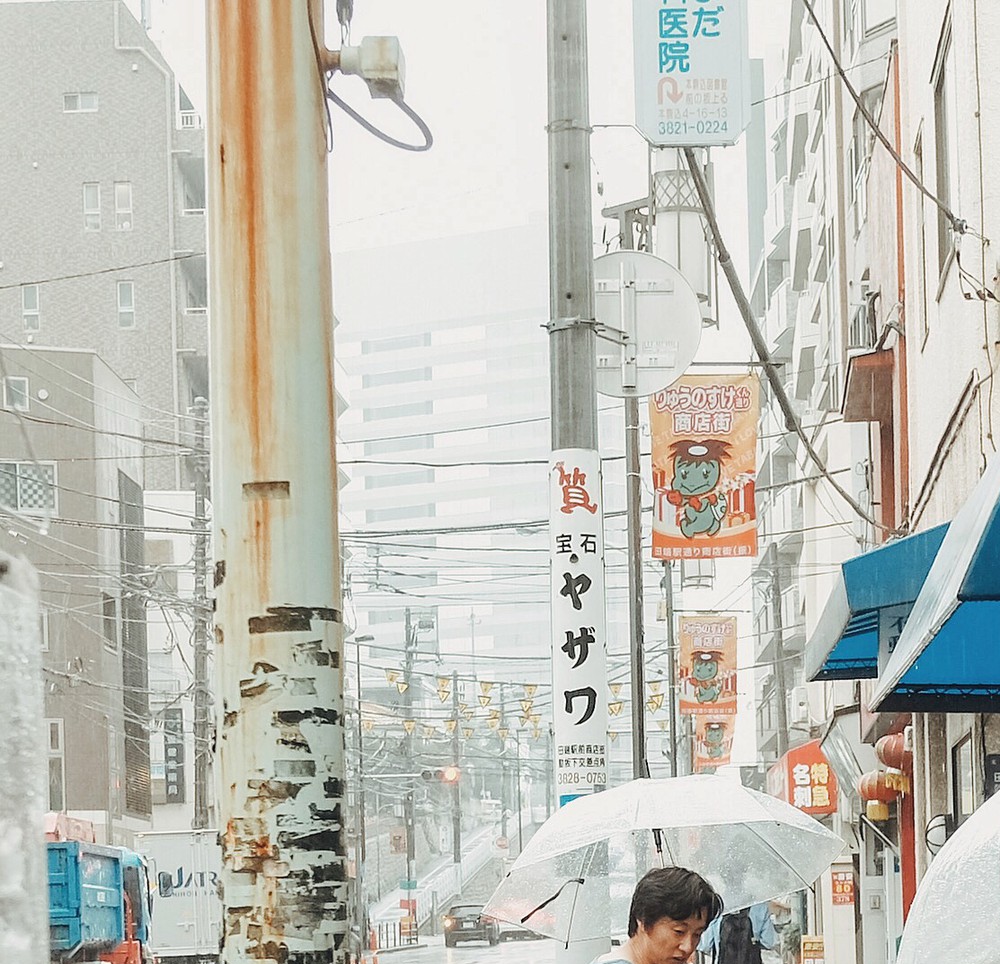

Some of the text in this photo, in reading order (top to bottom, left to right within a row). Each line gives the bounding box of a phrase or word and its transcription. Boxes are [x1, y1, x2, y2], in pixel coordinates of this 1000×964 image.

[658, 0, 690, 73] 医院
[692, 0, 725, 38] だ
[658, 121, 728, 135] 3821-0224
[674, 411, 732, 433] 商店街
[553, 461, 598, 514] 質
[556, 533, 597, 554] 宝石
[560, 572, 597, 725] ヤザワ
